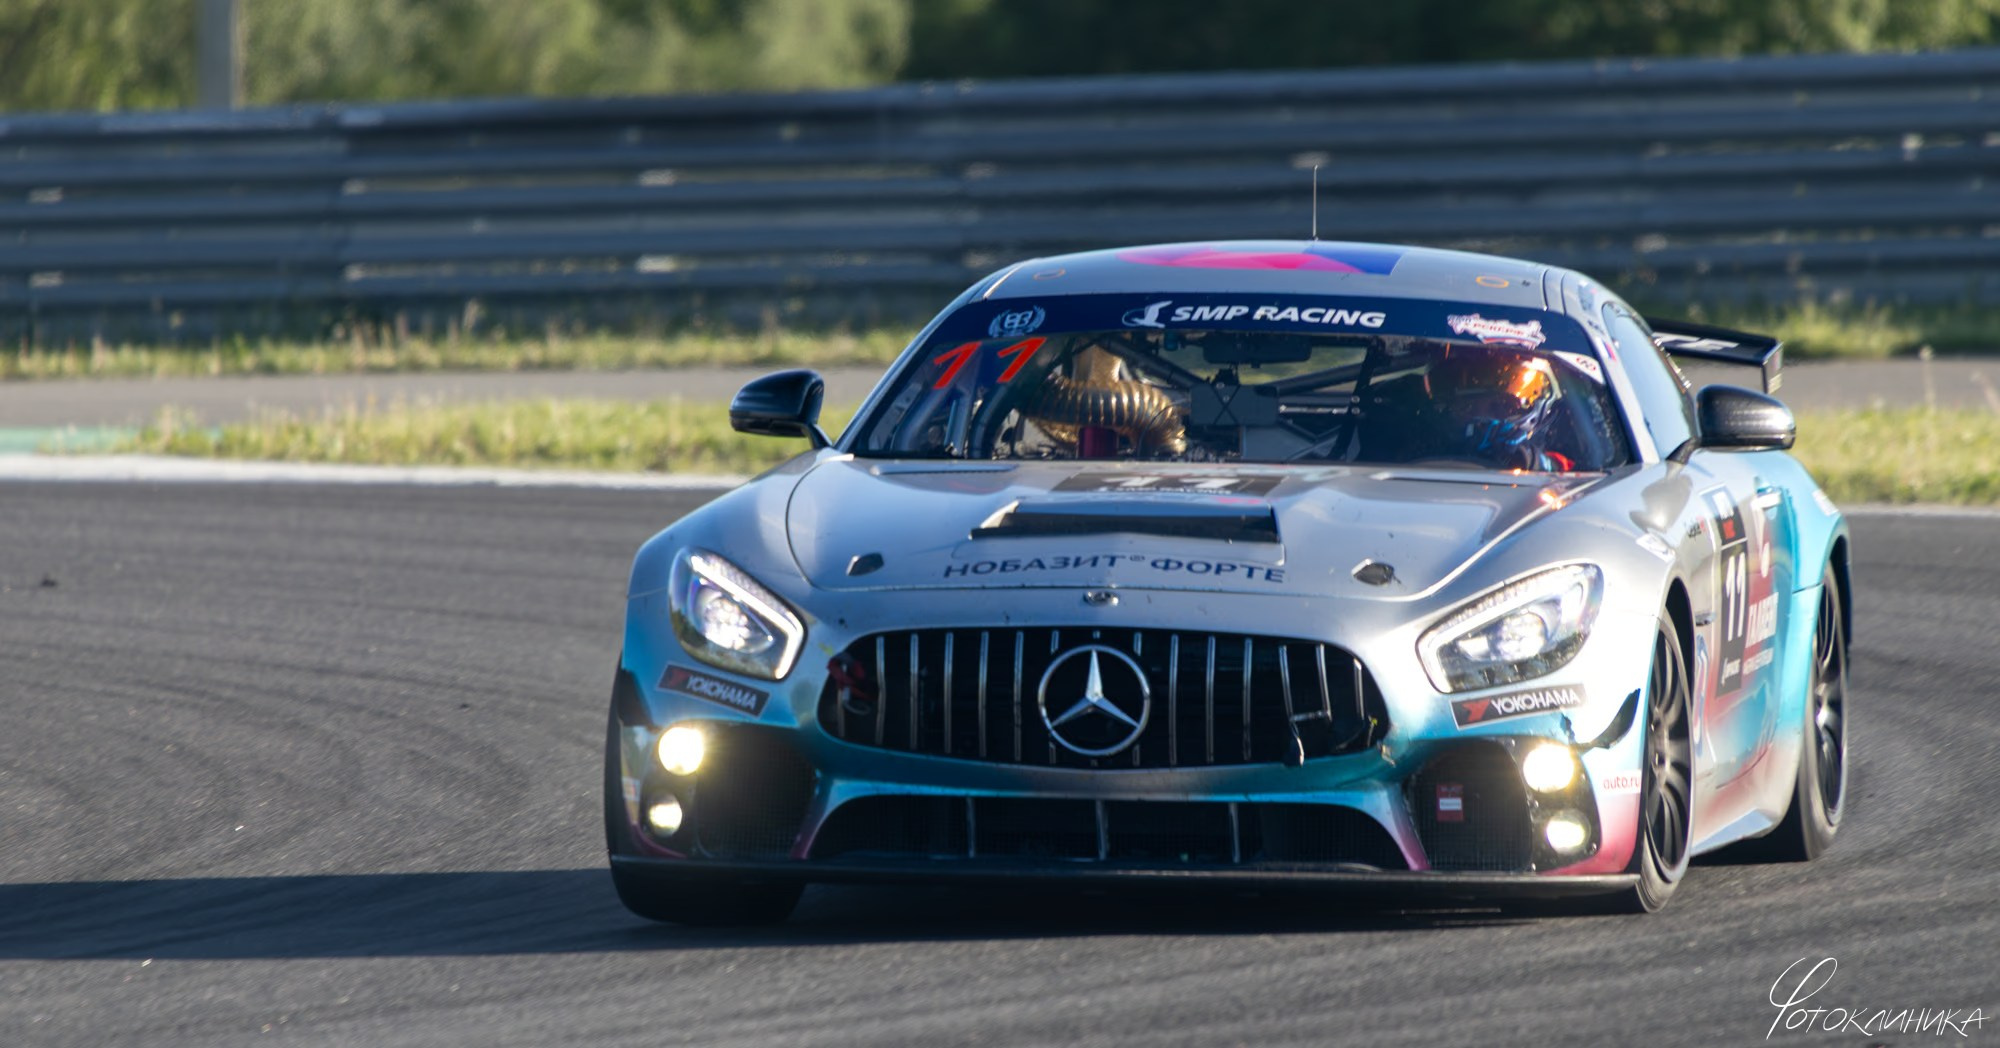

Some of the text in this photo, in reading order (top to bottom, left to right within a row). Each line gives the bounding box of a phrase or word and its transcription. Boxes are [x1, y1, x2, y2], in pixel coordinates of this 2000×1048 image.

[1170, 305, 1387, 328] SMP RACING
[933, 337, 1048, 390] 11
[1150, 557, 1286, 584] ФОРТЕ
[1726, 552, 1746, 642] 11
[686, 675, 757, 711] YOKOHAMA
[1491, 688, 1581, 715] YOKOHAMA
[1603, 775, 1641, 790] auto.ru
